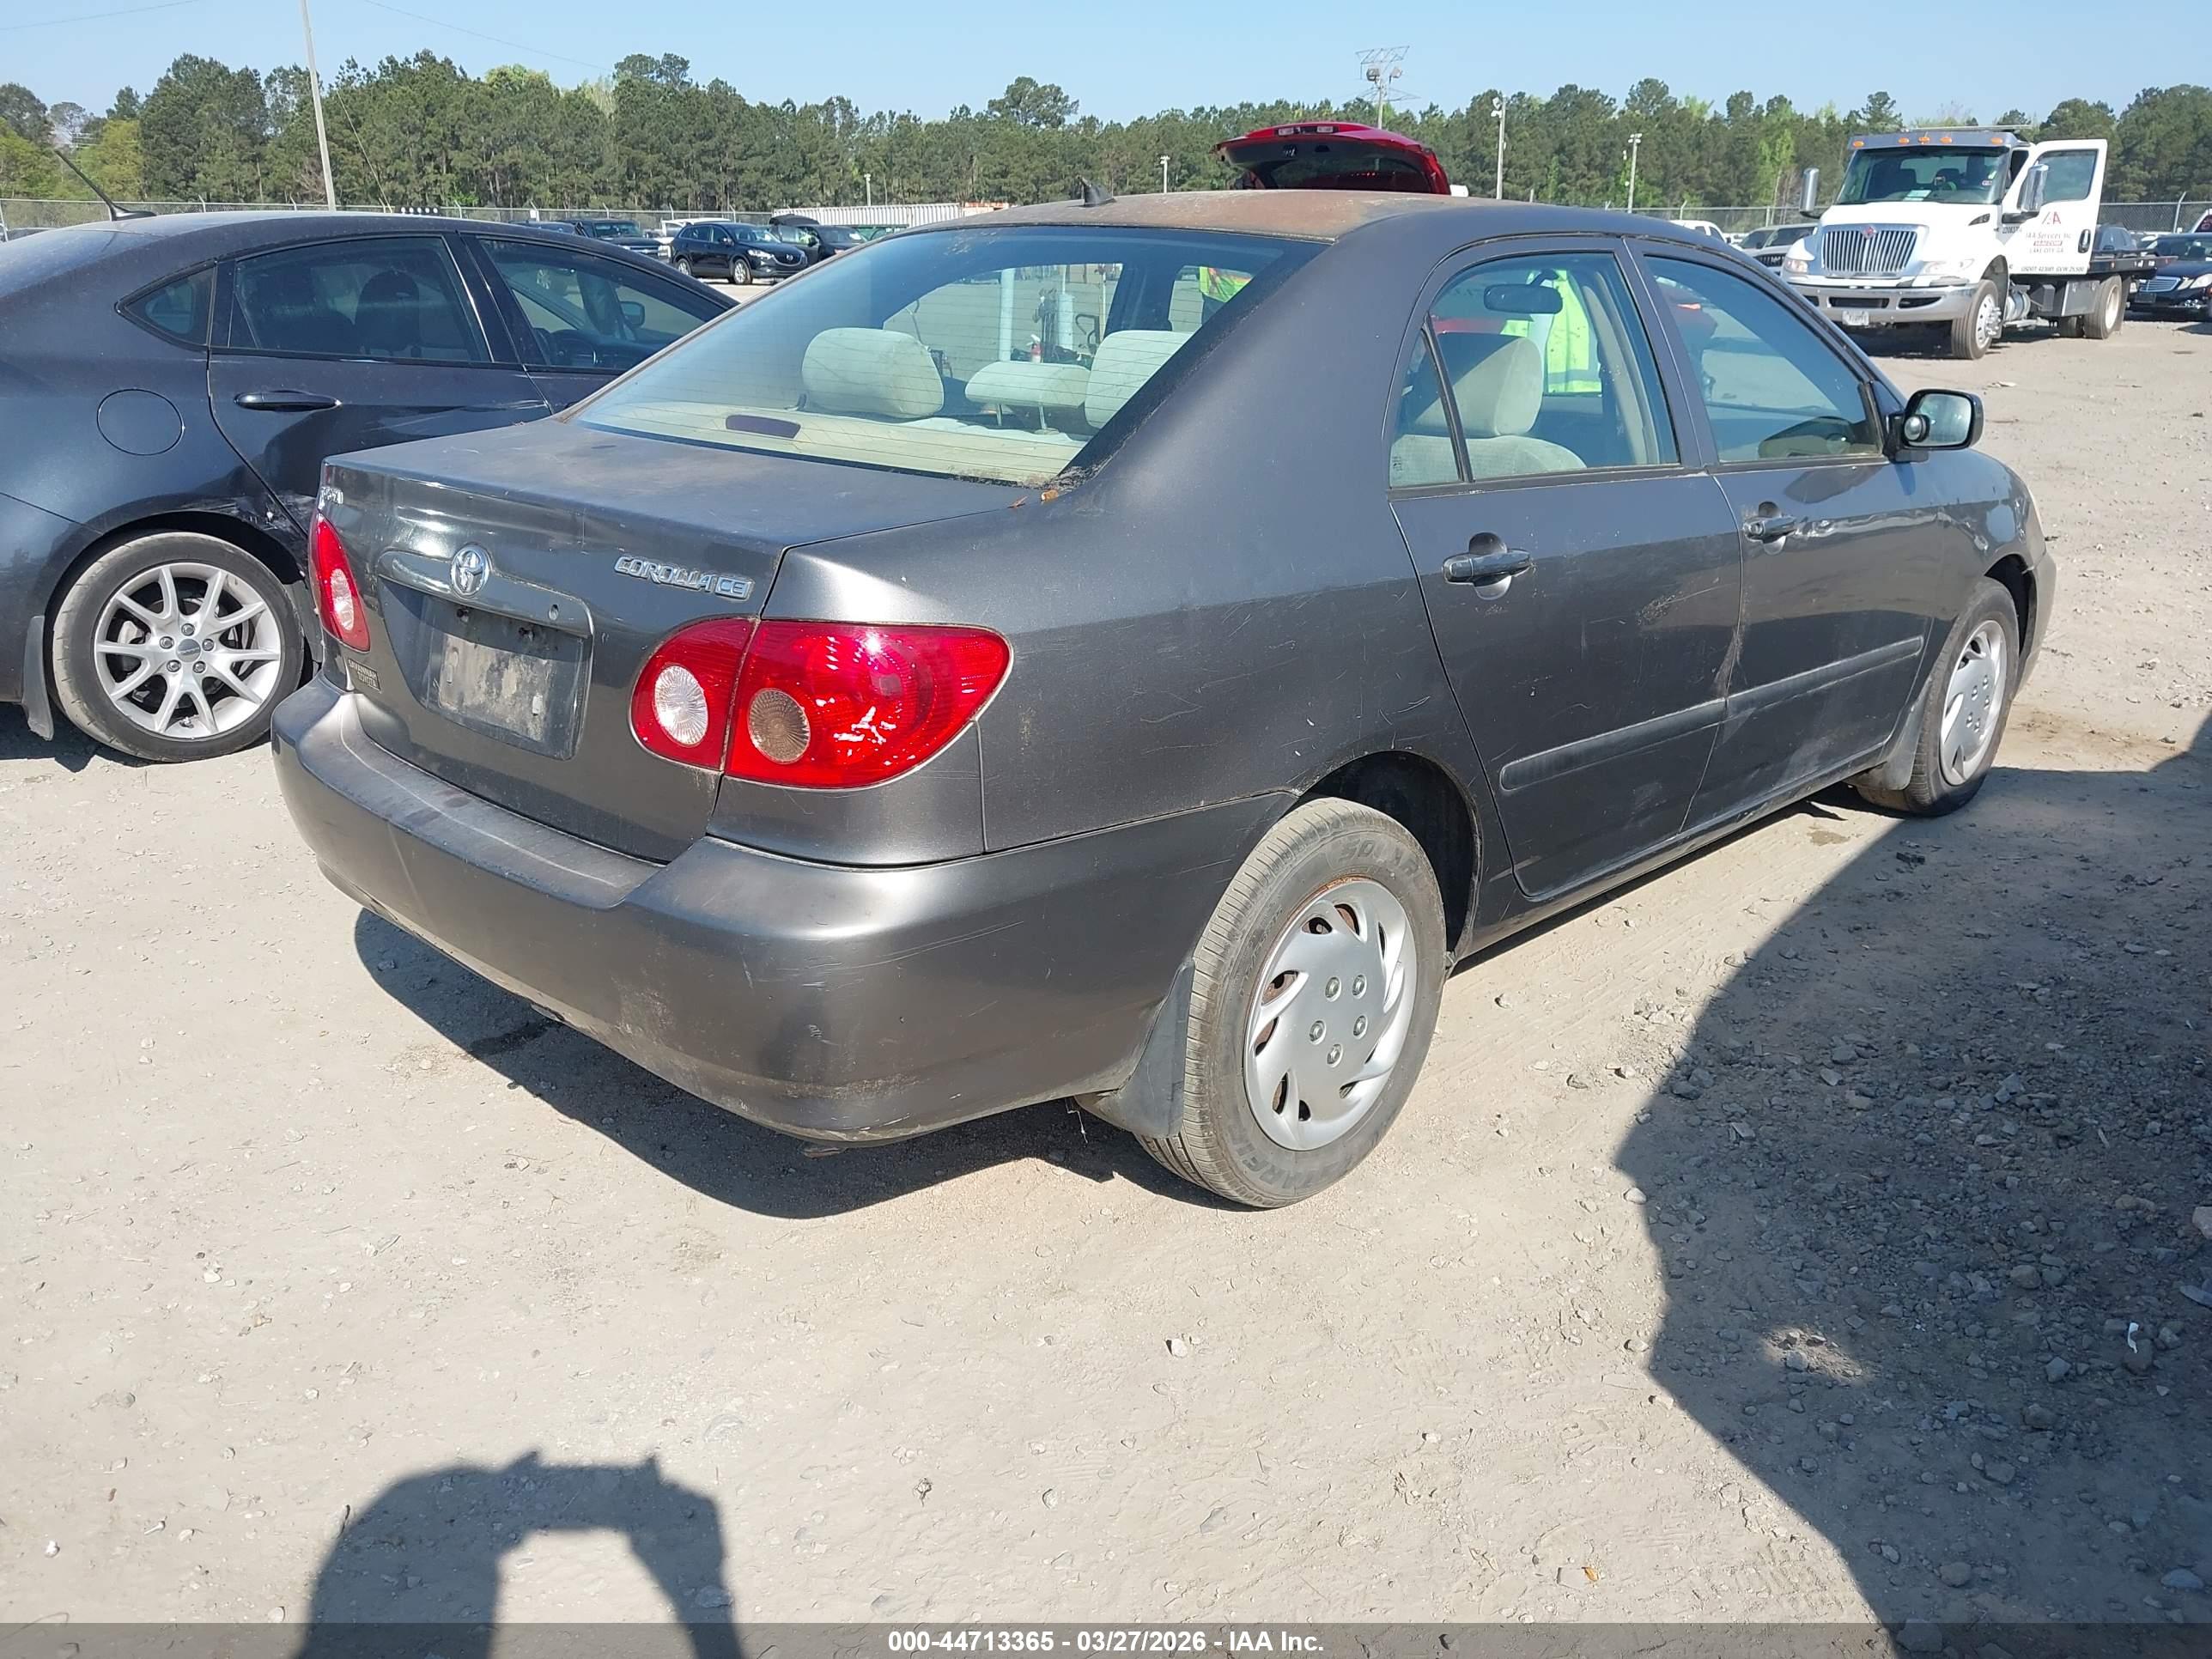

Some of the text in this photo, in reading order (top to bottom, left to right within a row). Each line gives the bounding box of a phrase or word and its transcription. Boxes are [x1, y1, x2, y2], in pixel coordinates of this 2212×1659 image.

[614, 556, 750, 598] COROLLA CE
[348, 659, 377, 680] SAVANNAH
[357, 672, 378, 688] TOYOTA
